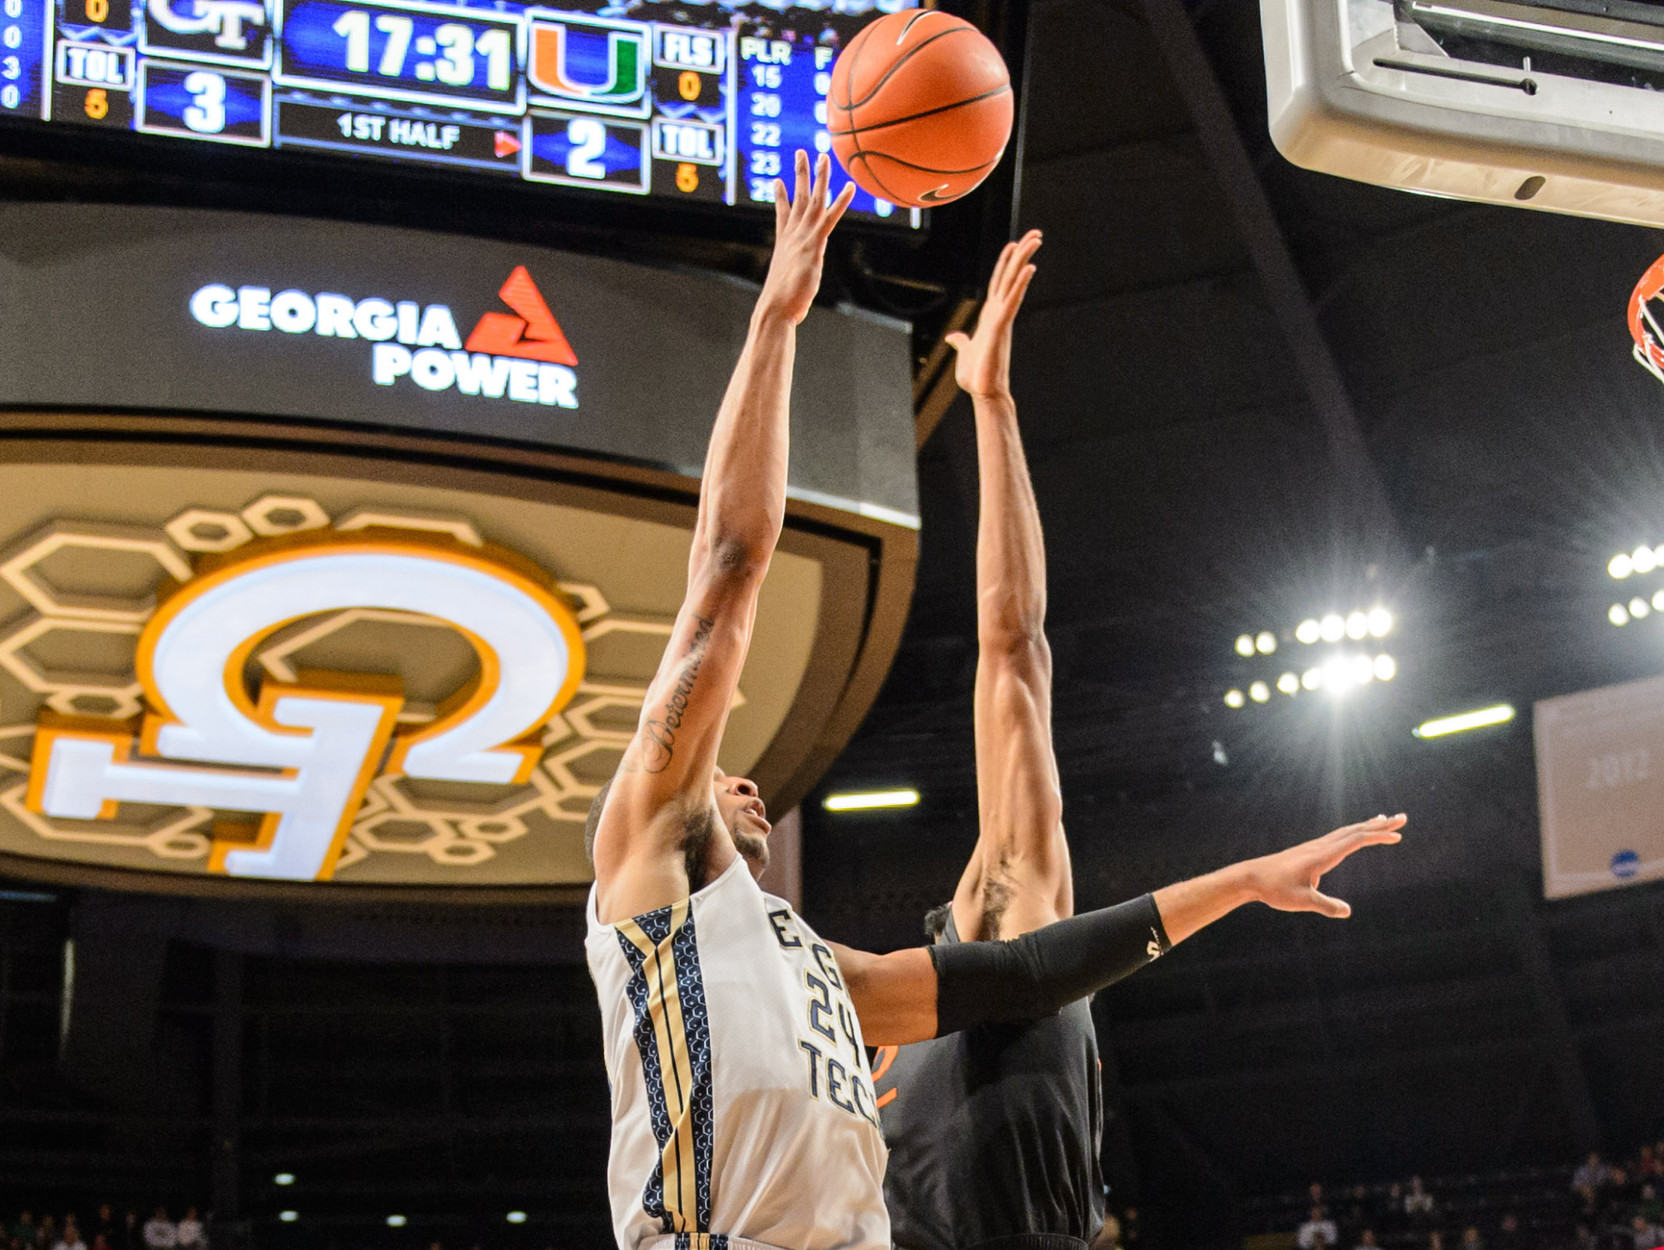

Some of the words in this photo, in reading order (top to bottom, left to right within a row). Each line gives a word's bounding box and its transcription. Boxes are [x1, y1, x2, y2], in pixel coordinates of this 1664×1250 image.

[67, 47, 123, 84] TOL
[332, 10, 511, 91] 17:31
[527, 20, 648, 104] U
[740, 37, 792, 65] PLR
[751, 65, 782, 89] 15
[183, 71, 226, 133] 3
[337, 112, 386, 141] 1ST
[388, 118, 460, 150] HALF
[566, 117, 606, 179] 2
[661, 124, 714, 159] TOL
[751, 122, 782, 147] 22
[751, 151, 782, 176] 23
[190, 283, 462, 349] GEORGIA
[372, 342, 579, 409] POWER
[804, 966, 863, 1074] 24
[798, 1037, 881, 1130] TEC
